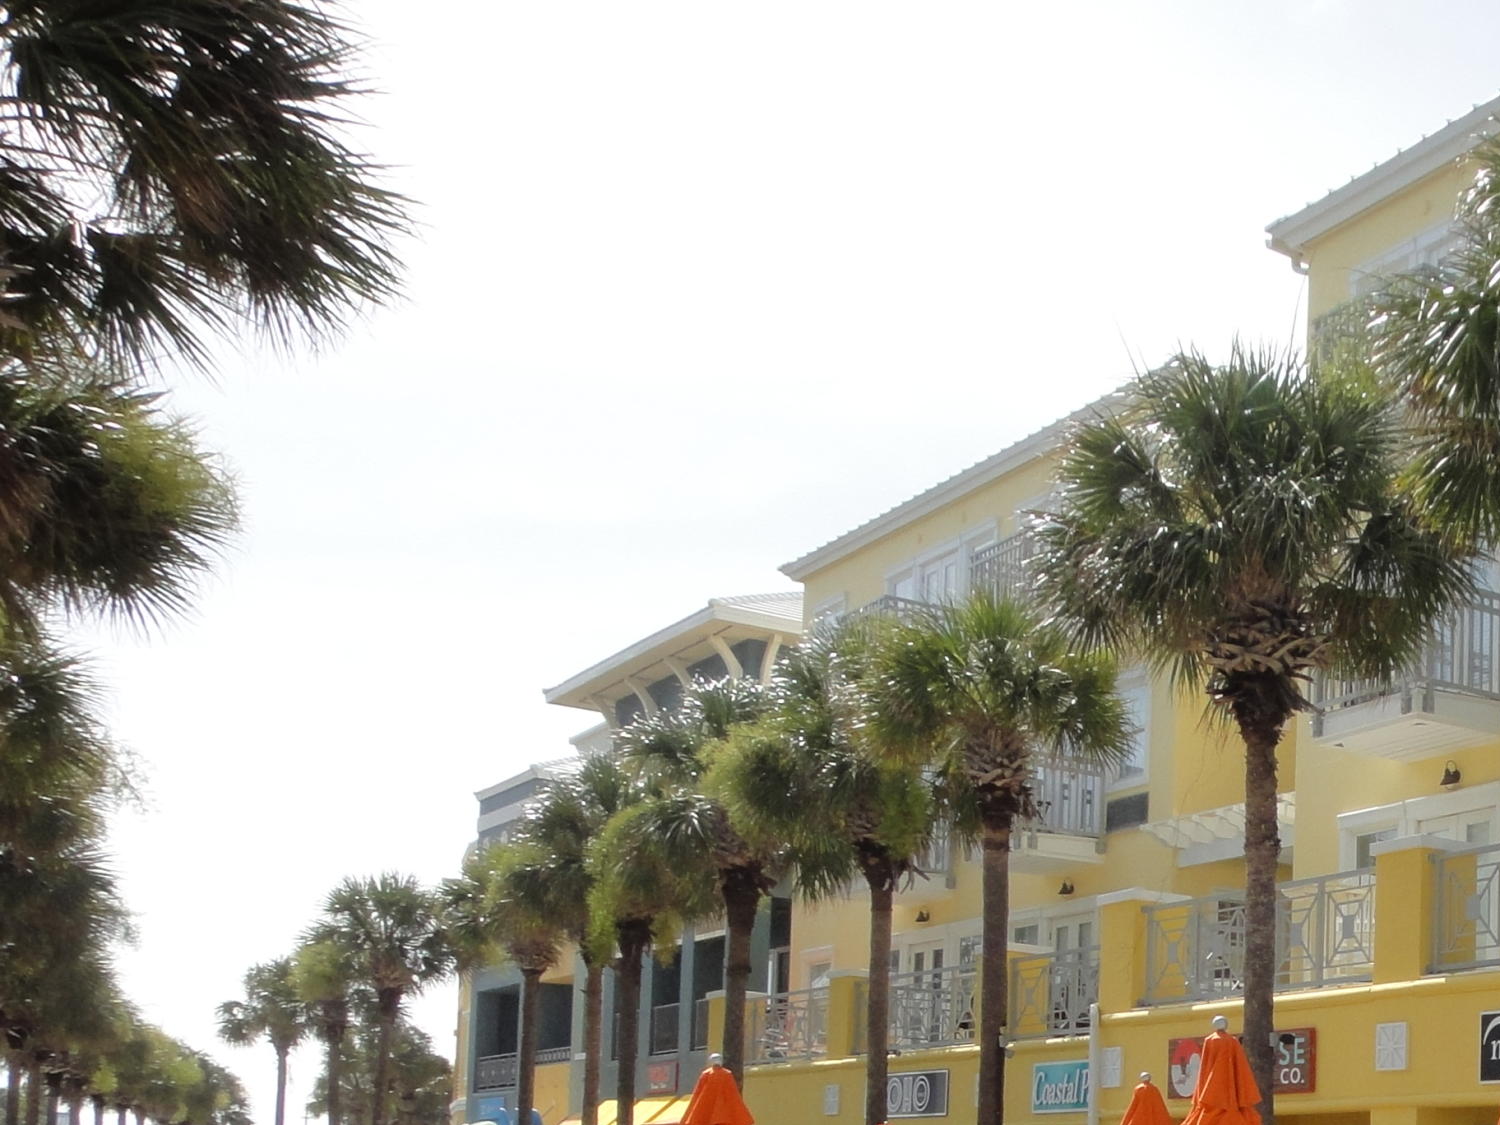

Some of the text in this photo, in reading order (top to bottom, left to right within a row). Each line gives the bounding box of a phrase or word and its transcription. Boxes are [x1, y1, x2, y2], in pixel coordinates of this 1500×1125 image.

[886, 1075, 931, 1113] OHO
[1033, 1067, 1081, 1106] Coastal
[1279, 1067, 1305, 1085] CO.
